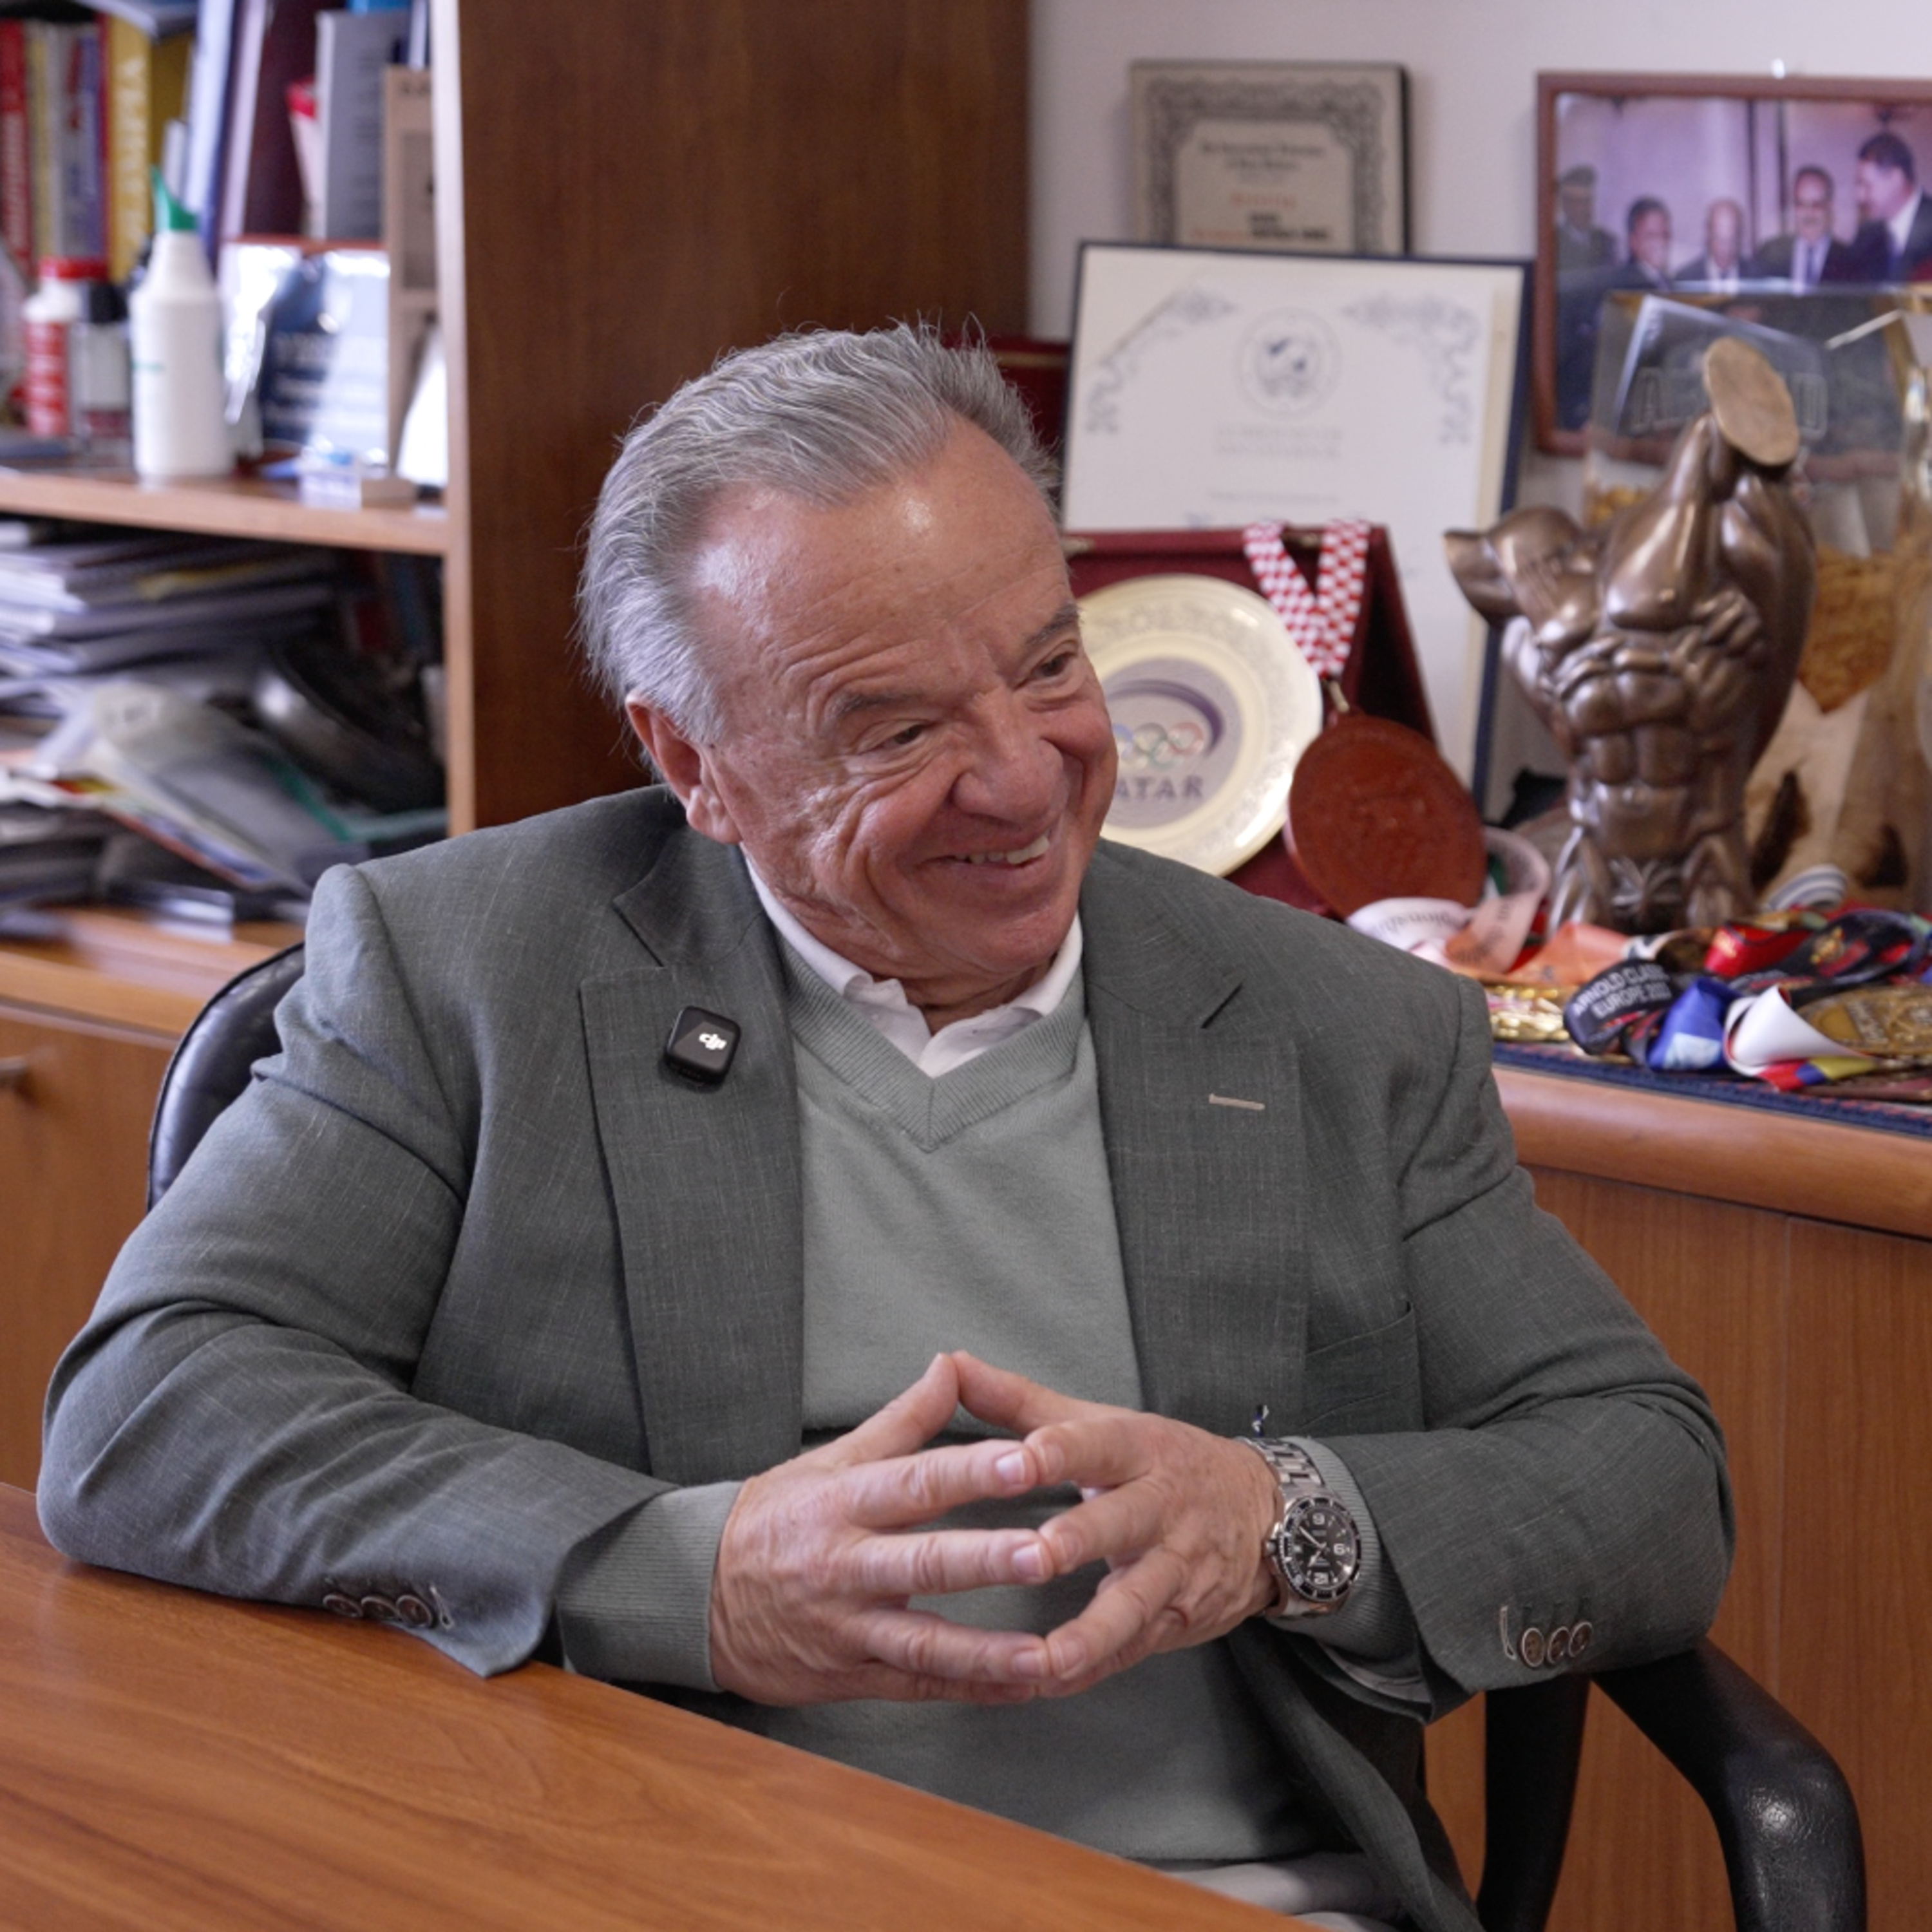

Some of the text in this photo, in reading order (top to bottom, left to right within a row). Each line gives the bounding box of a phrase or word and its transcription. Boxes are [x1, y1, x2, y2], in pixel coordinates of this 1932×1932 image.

[1117, 775, 1203, 800] ATAR
[1573, 972, 1625, 1016] ARNOLD
[1591, 985, 1649, 1019] EUROPE
